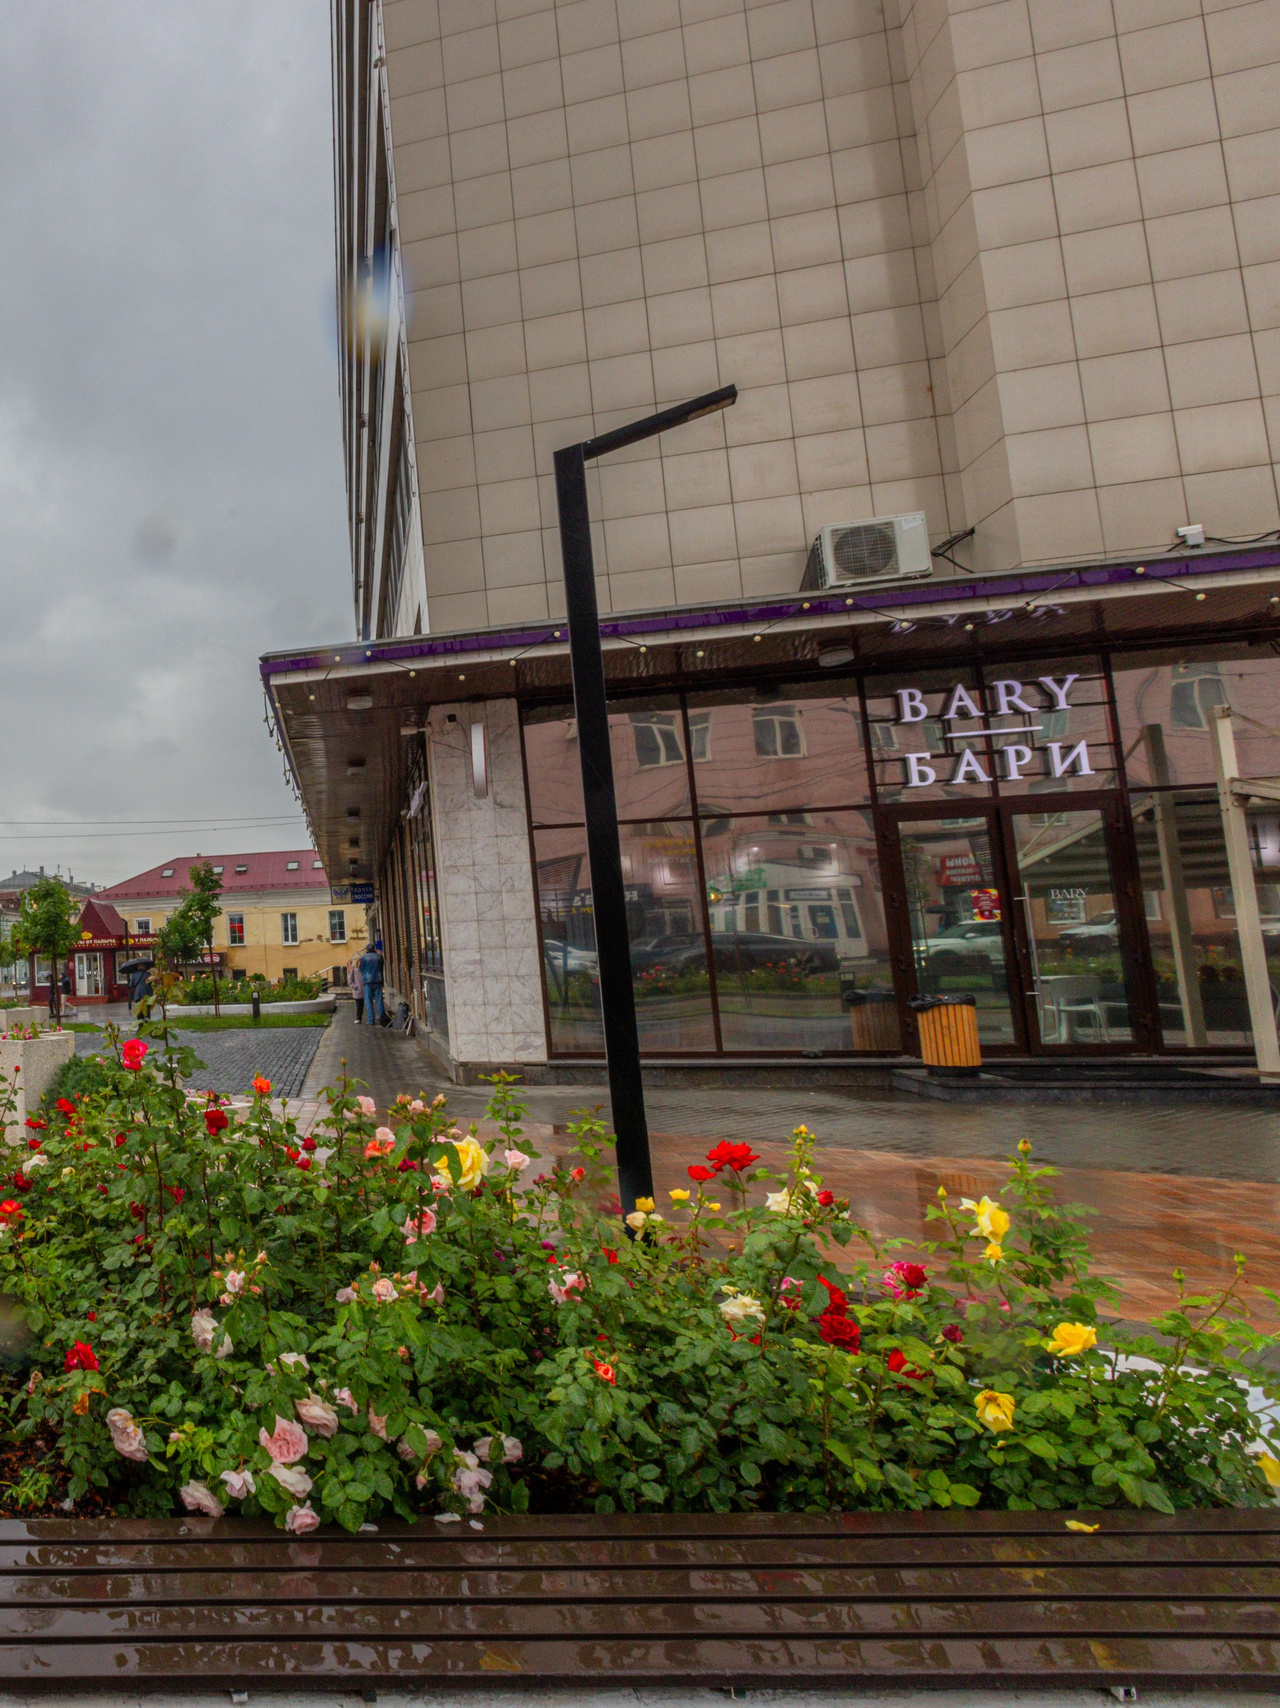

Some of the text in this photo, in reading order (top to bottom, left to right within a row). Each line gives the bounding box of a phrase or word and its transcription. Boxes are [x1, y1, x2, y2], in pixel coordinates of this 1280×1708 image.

[897, 674, 1080, 723] BARY
[904, 740, 1095, 788] БАРИ
[1050, 887, 1088, 899] BARY
